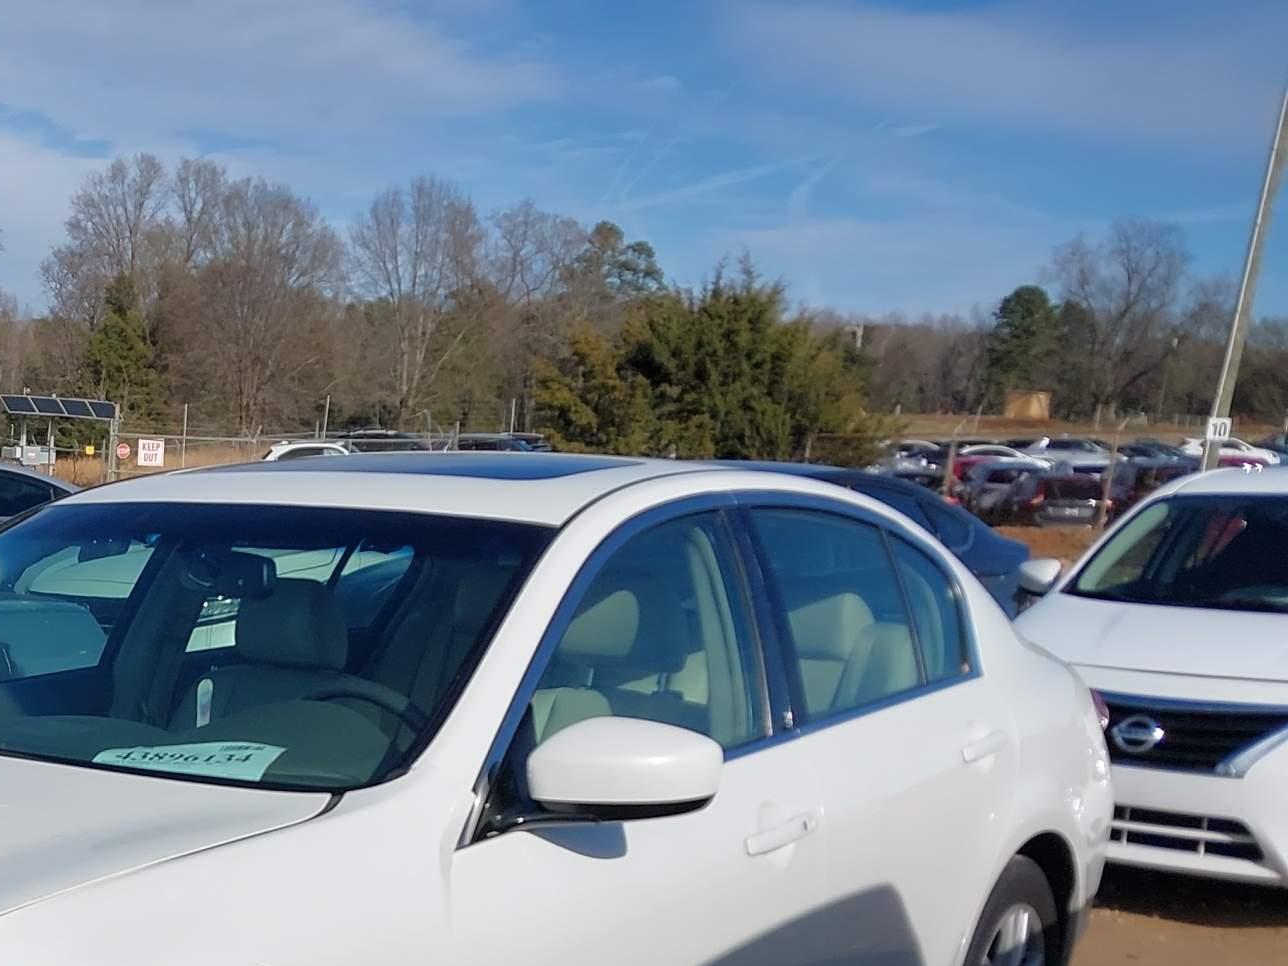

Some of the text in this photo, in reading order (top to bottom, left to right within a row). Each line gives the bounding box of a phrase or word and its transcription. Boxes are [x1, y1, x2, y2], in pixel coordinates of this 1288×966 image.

[1212, 422, 1228, 437] 10
[141, 442, 161, 452] KEEP
[143, 453, 158, 462] OUT
[115, 751, 254, 763] 43896134
